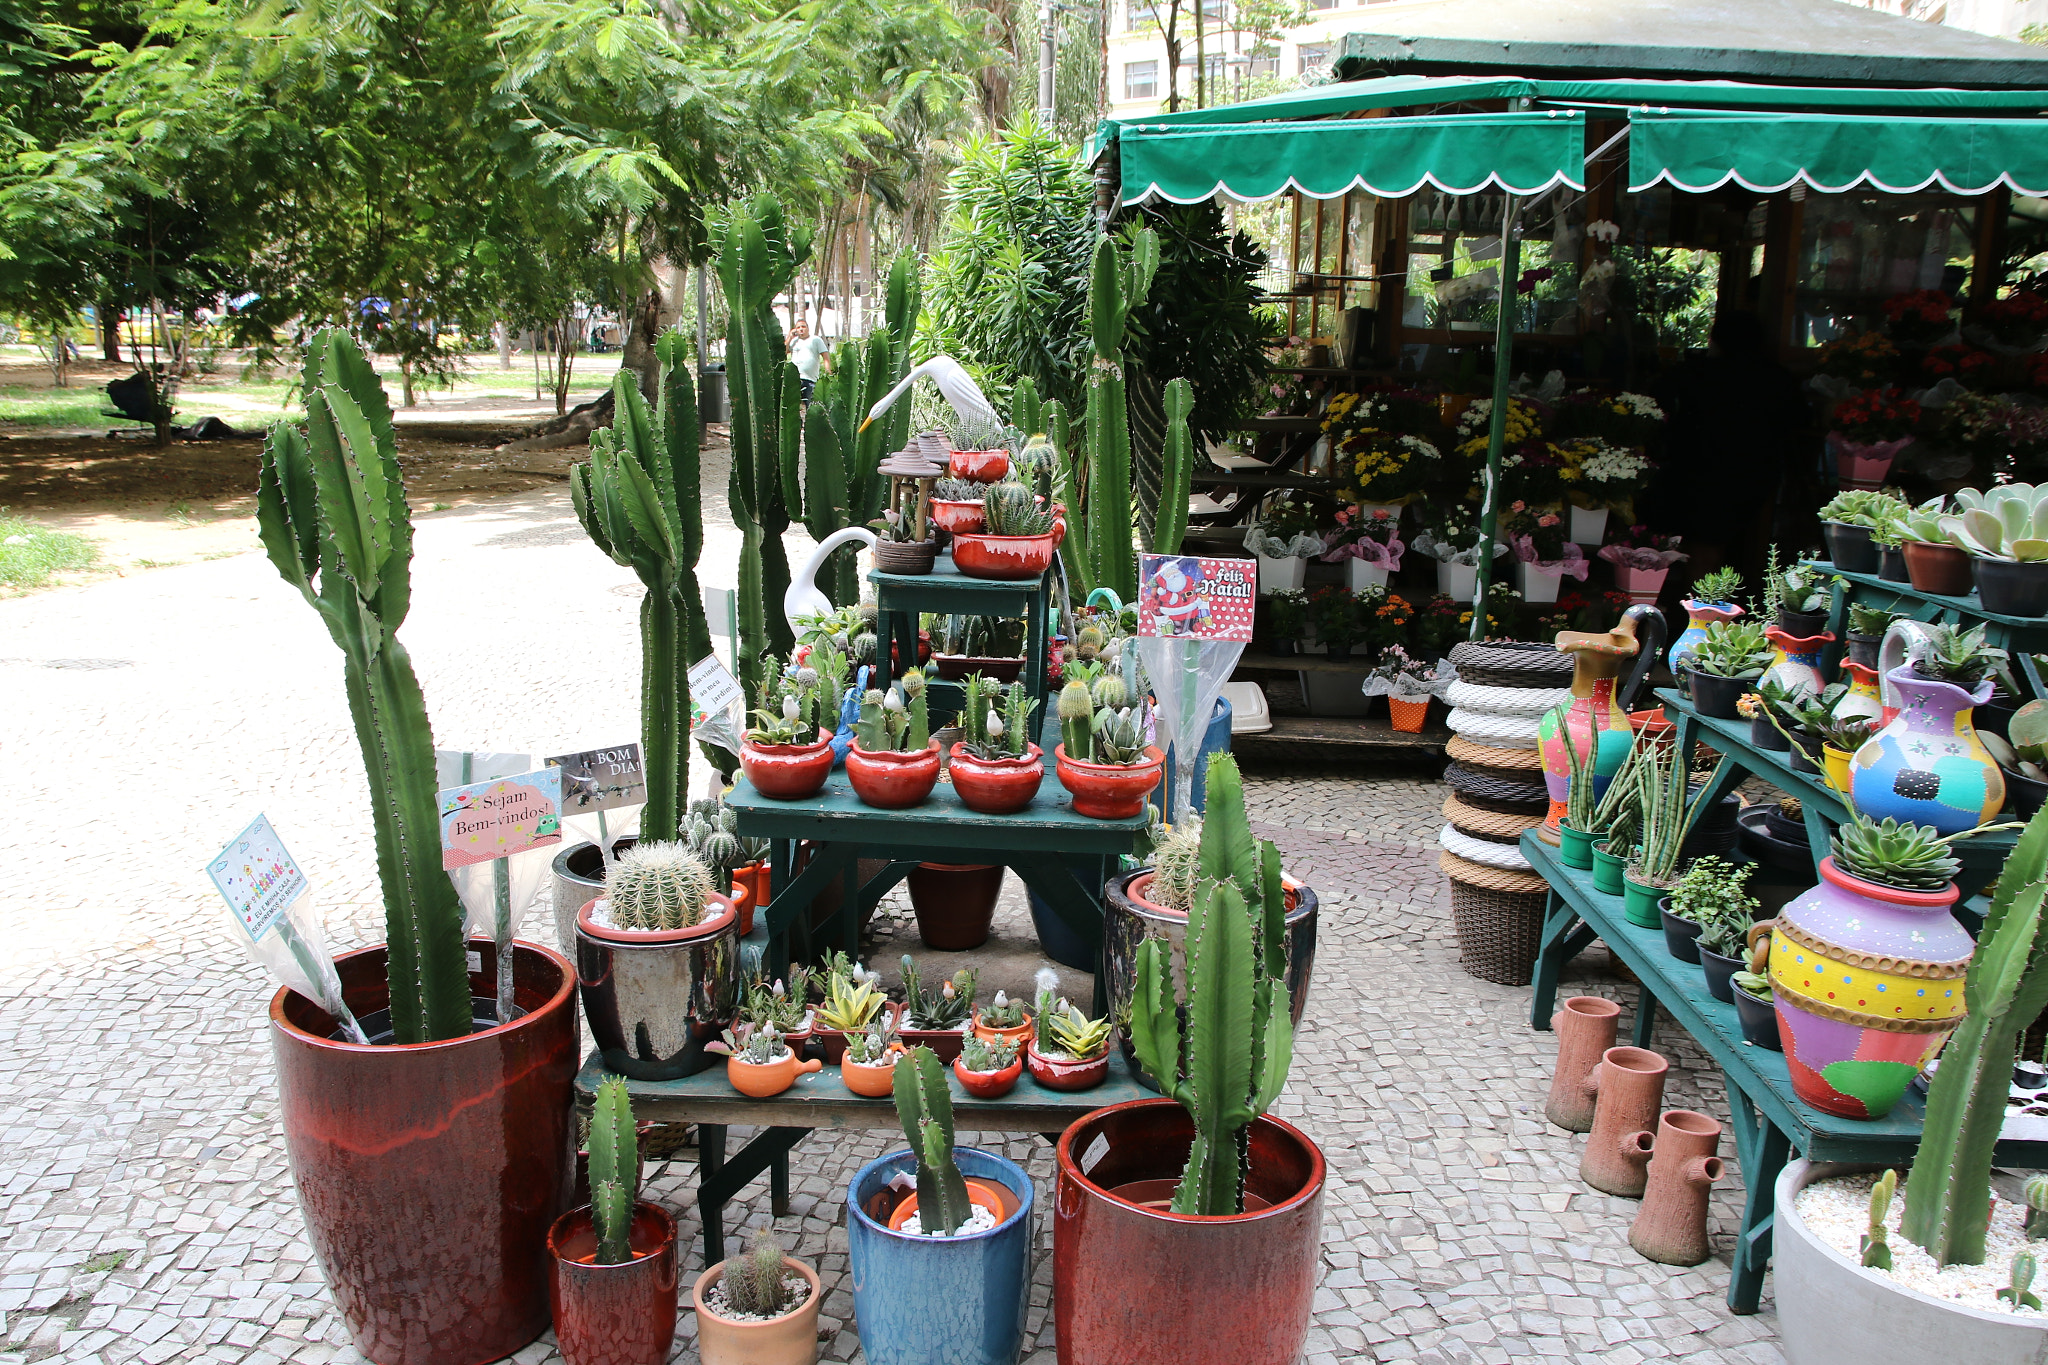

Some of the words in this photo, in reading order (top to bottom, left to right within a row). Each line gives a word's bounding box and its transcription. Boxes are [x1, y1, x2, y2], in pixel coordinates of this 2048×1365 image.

[1201, 580, 1251, 598] Natal!
[699, 689, 708, 697] ao
[707, 679, 721, 691] meu
[711, 683, 734, 704] jardim!
[596, 748, 632, 765] BOM
[610, 760, 641, 776] DIA!
[483, 790, 528, 812] Sejam
[456, 802, 550, 836] Bem-vindos!
[254, 909, 263, 919] EU
[261, 904, 267, 912] E
[264, 890, 280, 908] MINHA
[278, 878, 291, 892] CASA
[251, 901, 280, 934] SERVIREMOS
[279, 894, 287, 904] AO
